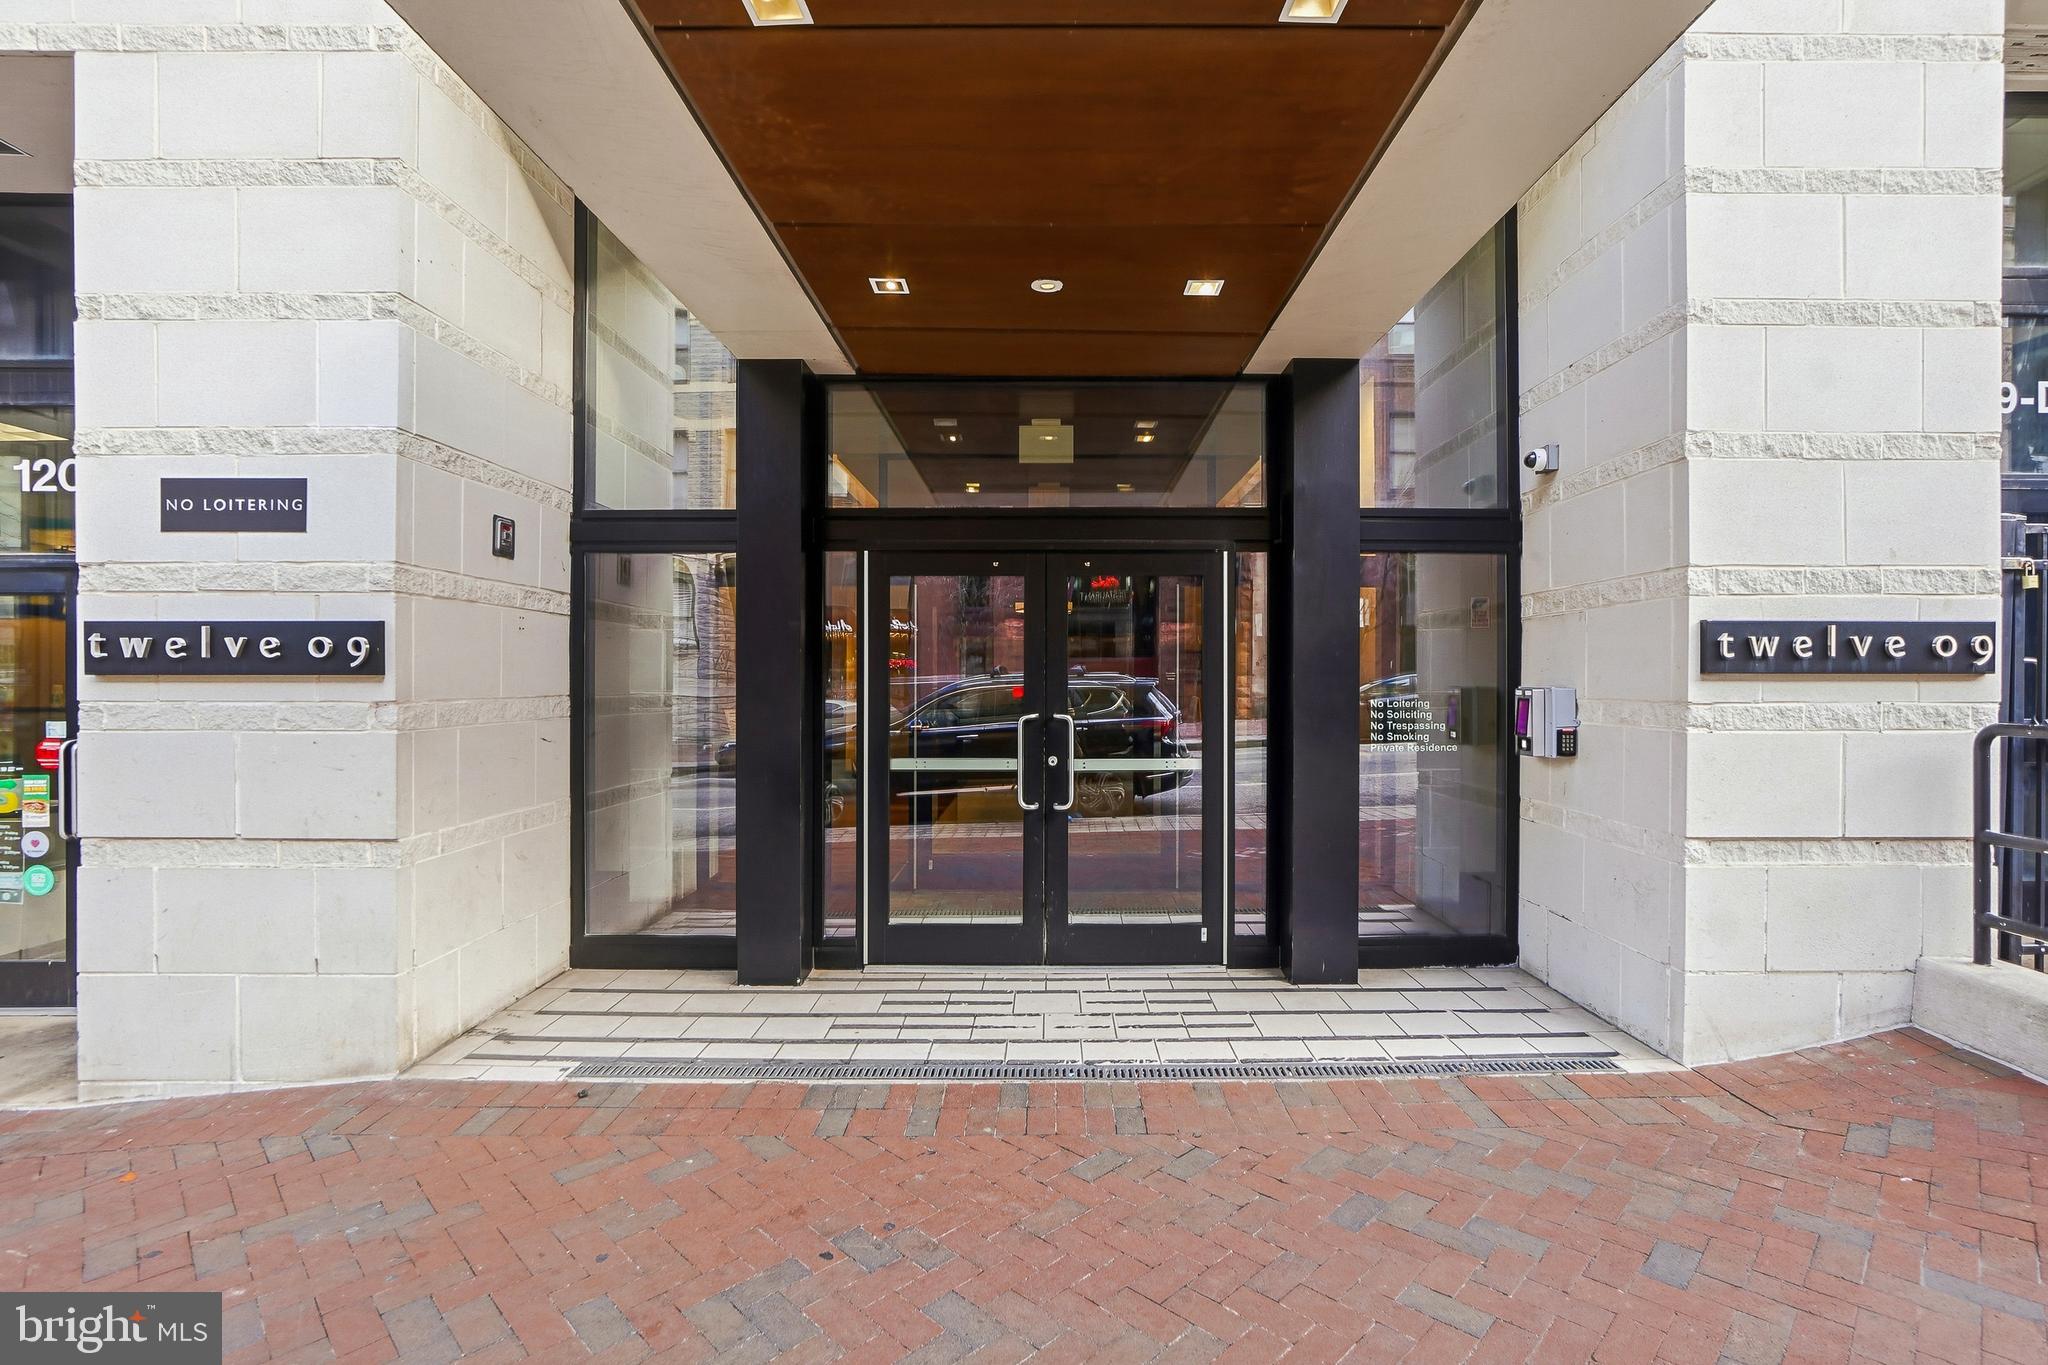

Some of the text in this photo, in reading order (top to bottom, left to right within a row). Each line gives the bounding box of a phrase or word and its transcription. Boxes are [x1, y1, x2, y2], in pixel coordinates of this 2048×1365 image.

[166, 498, 303, 511] NO LOITERING
[88, 625, 370, 668] twelve 09
[1718, 625, 1993, 667] twelve 09
[1370, 699, 1430, 710] No Loitering
[1370, 710, 1432, 721] No Soliciting
[1370, 721, 1446, 732] No Trespassing
[1370, 732, 1430, 743] No Smoking
[1370, 743, 1458, 752] Private Residence
